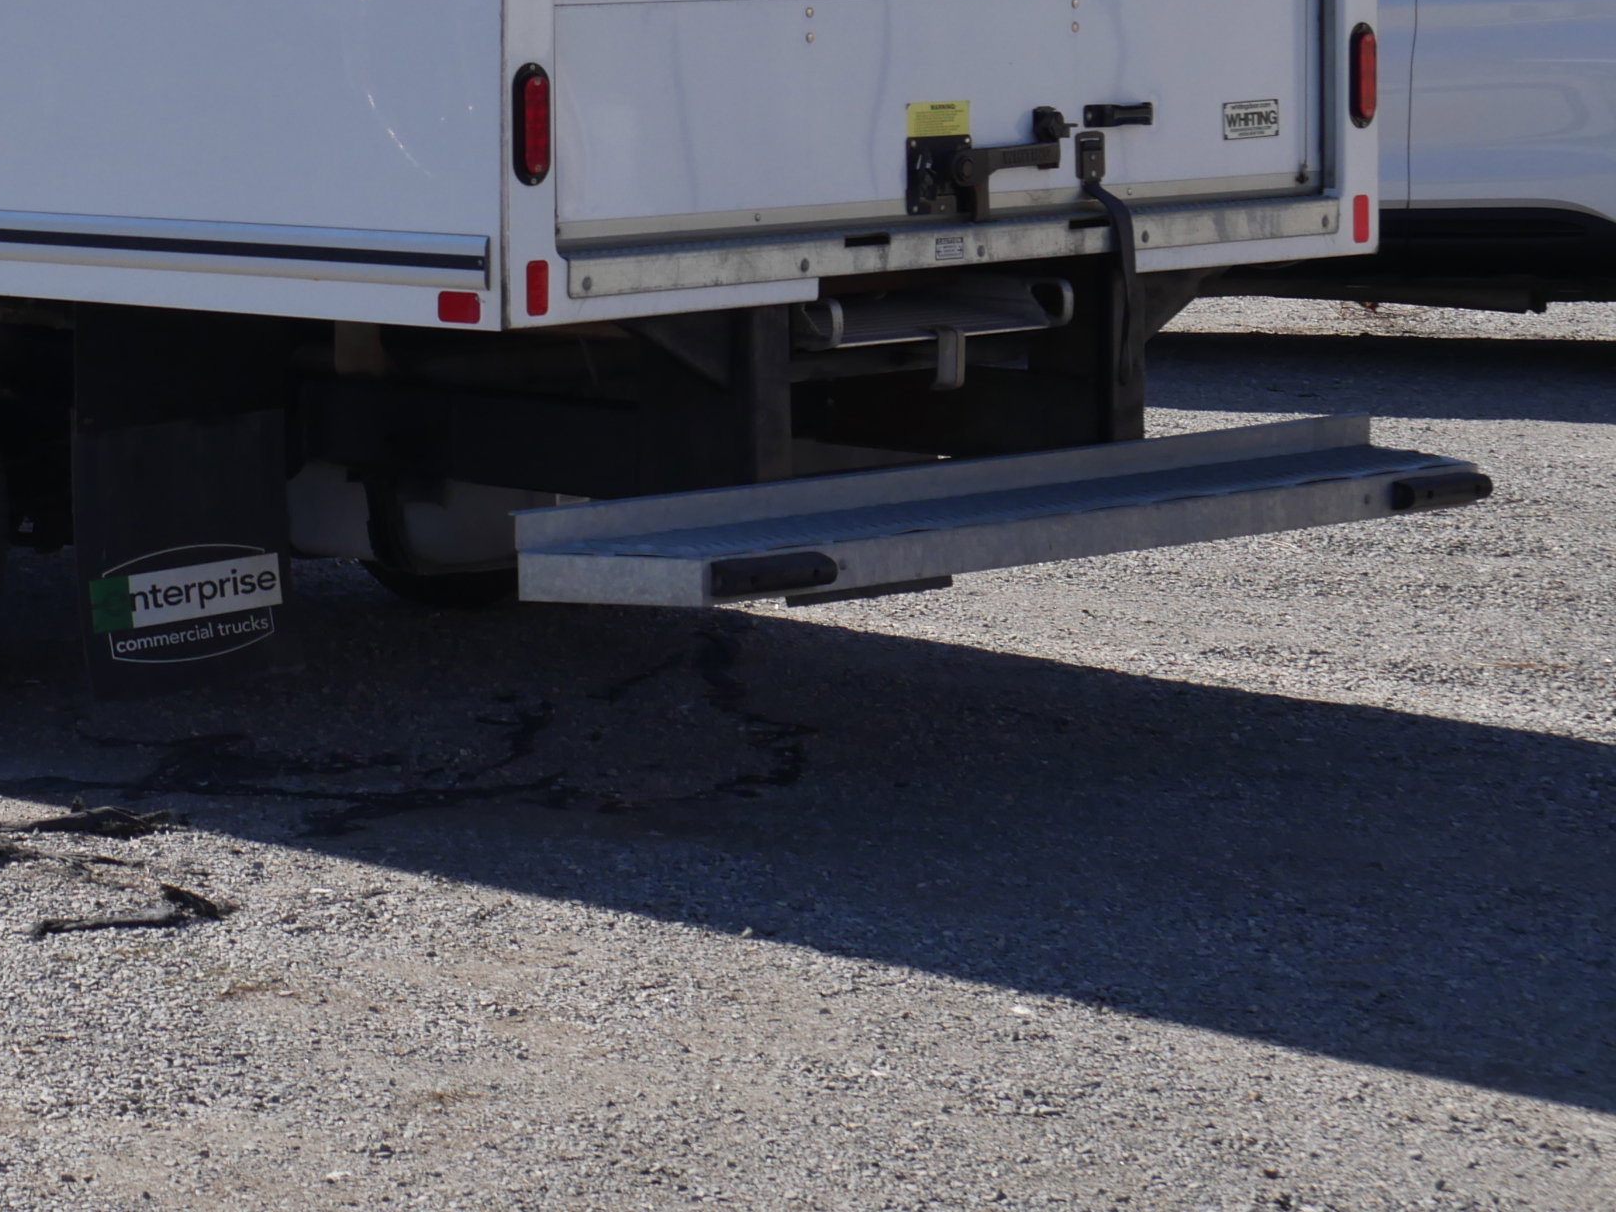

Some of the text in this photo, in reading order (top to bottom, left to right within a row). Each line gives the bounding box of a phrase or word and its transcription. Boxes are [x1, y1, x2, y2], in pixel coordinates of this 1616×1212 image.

[1225, 109, 1278, 128] WHITING
[92, 569, 277, 616] nterprise
[116, 615, 269, 654] commercial trucks
